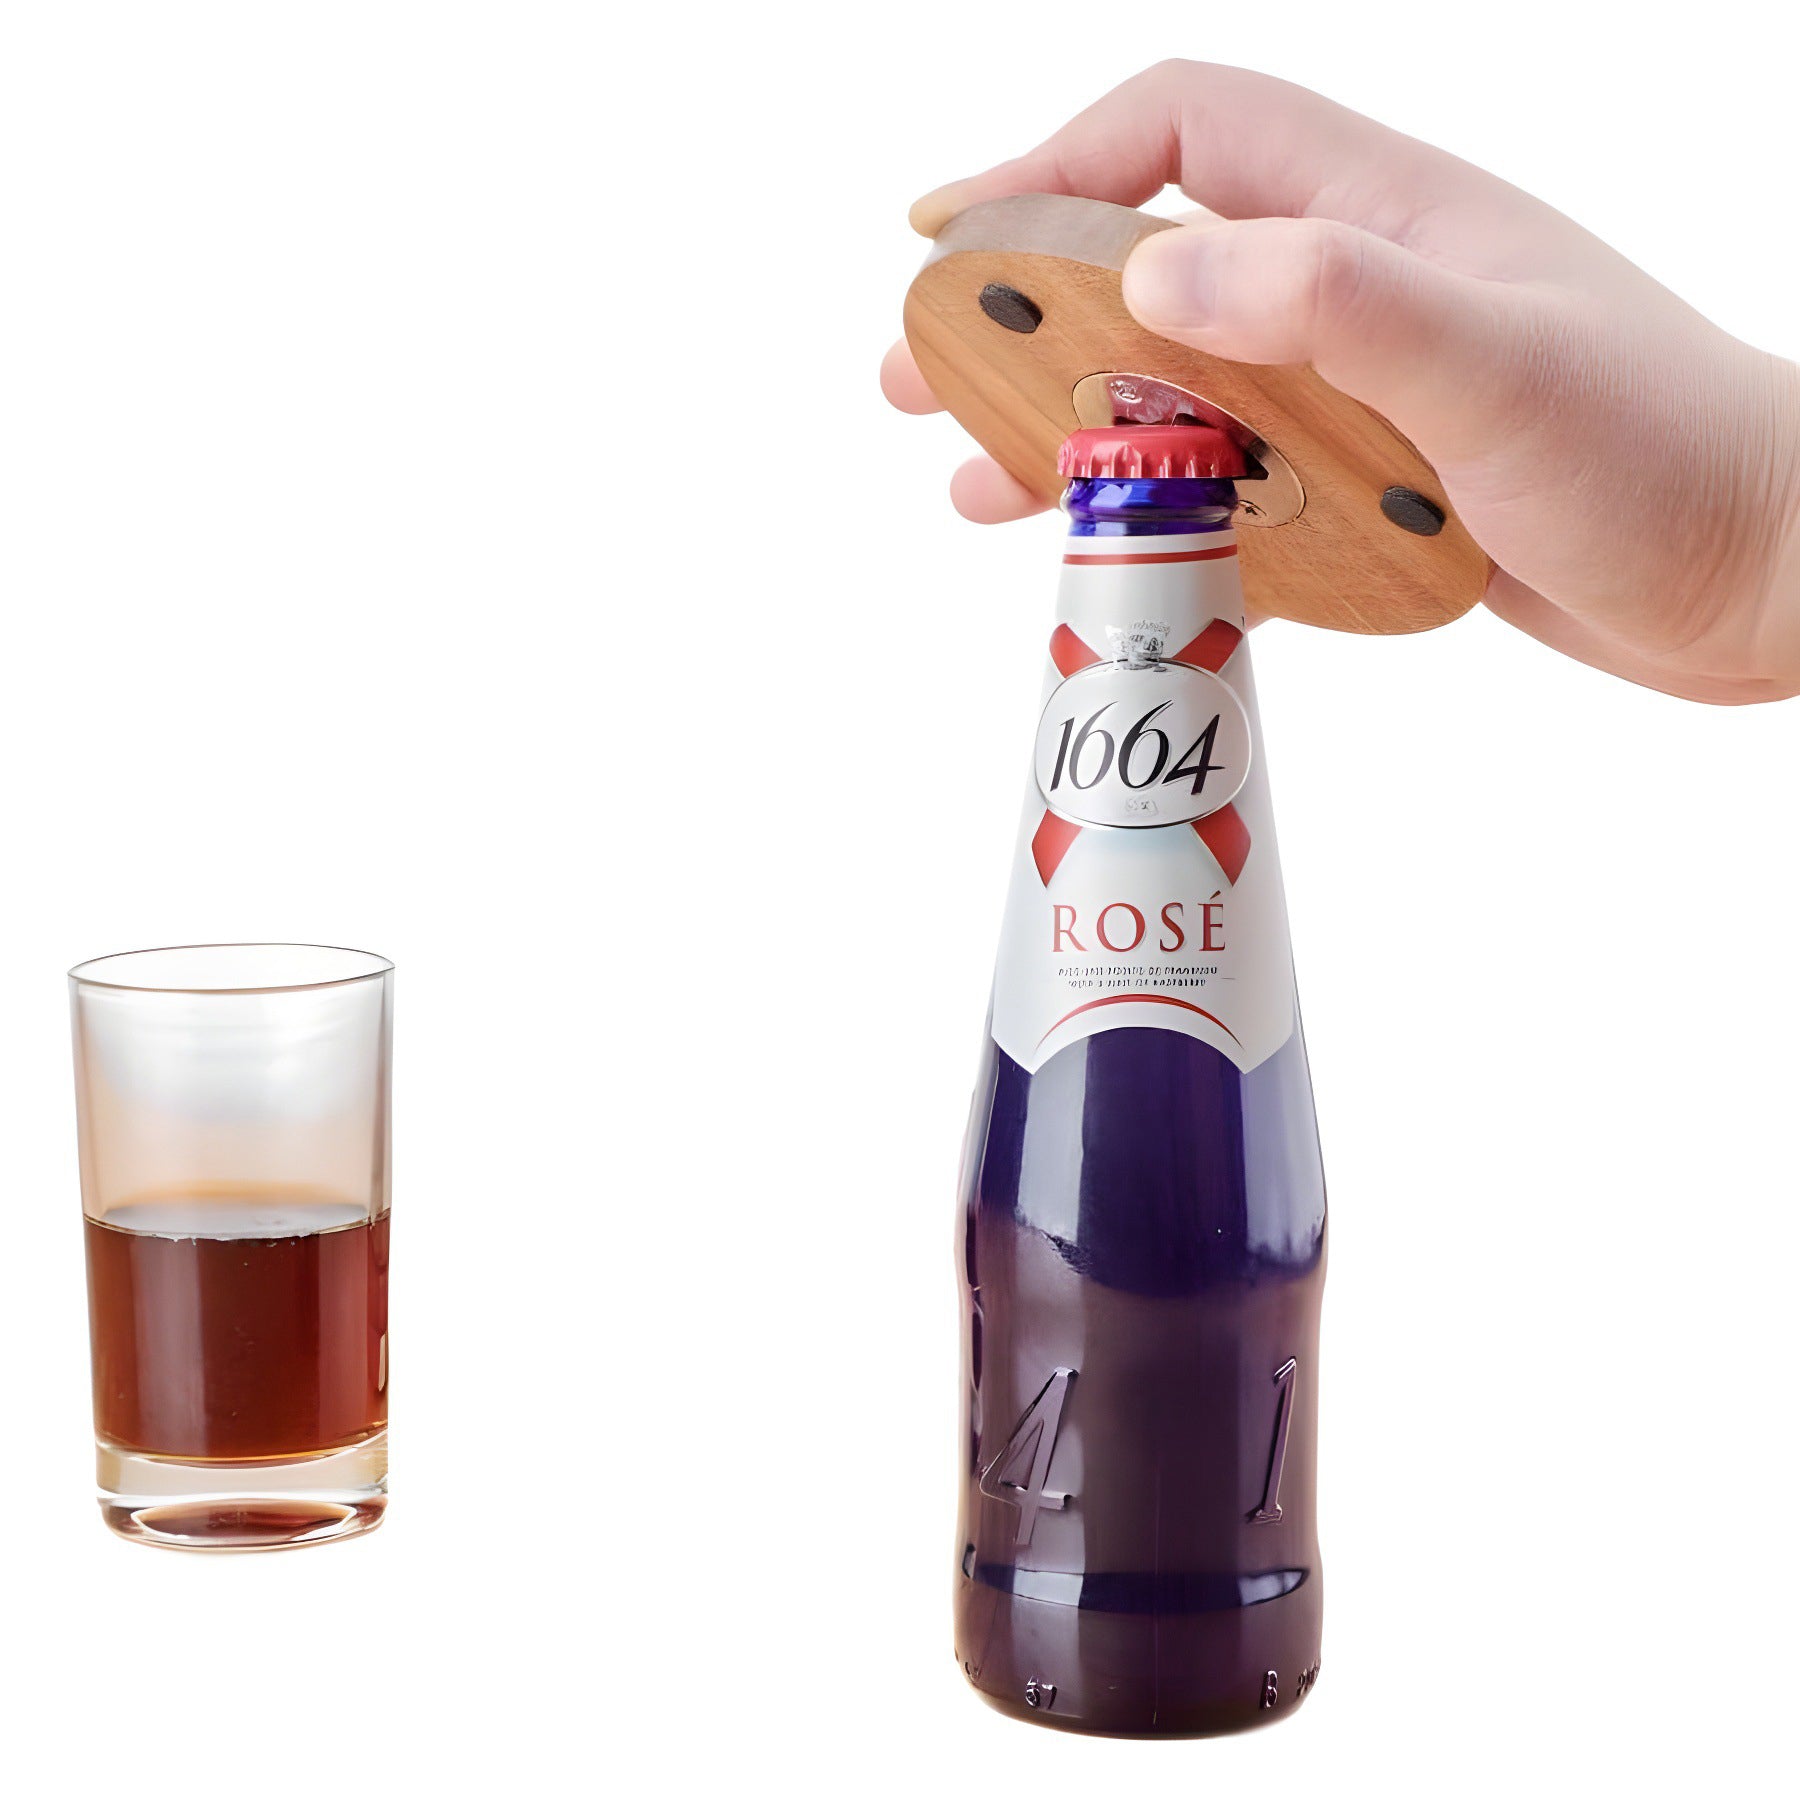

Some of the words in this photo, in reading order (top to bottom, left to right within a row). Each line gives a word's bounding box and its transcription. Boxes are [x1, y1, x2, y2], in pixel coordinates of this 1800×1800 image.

[1050, 700, 1225, 795] 1664
[1052, 890, 1226, 953] ROSÉ
[980, 1366, 1079, 1545] 4
[1247, 1356, 1297, 1524] 1
